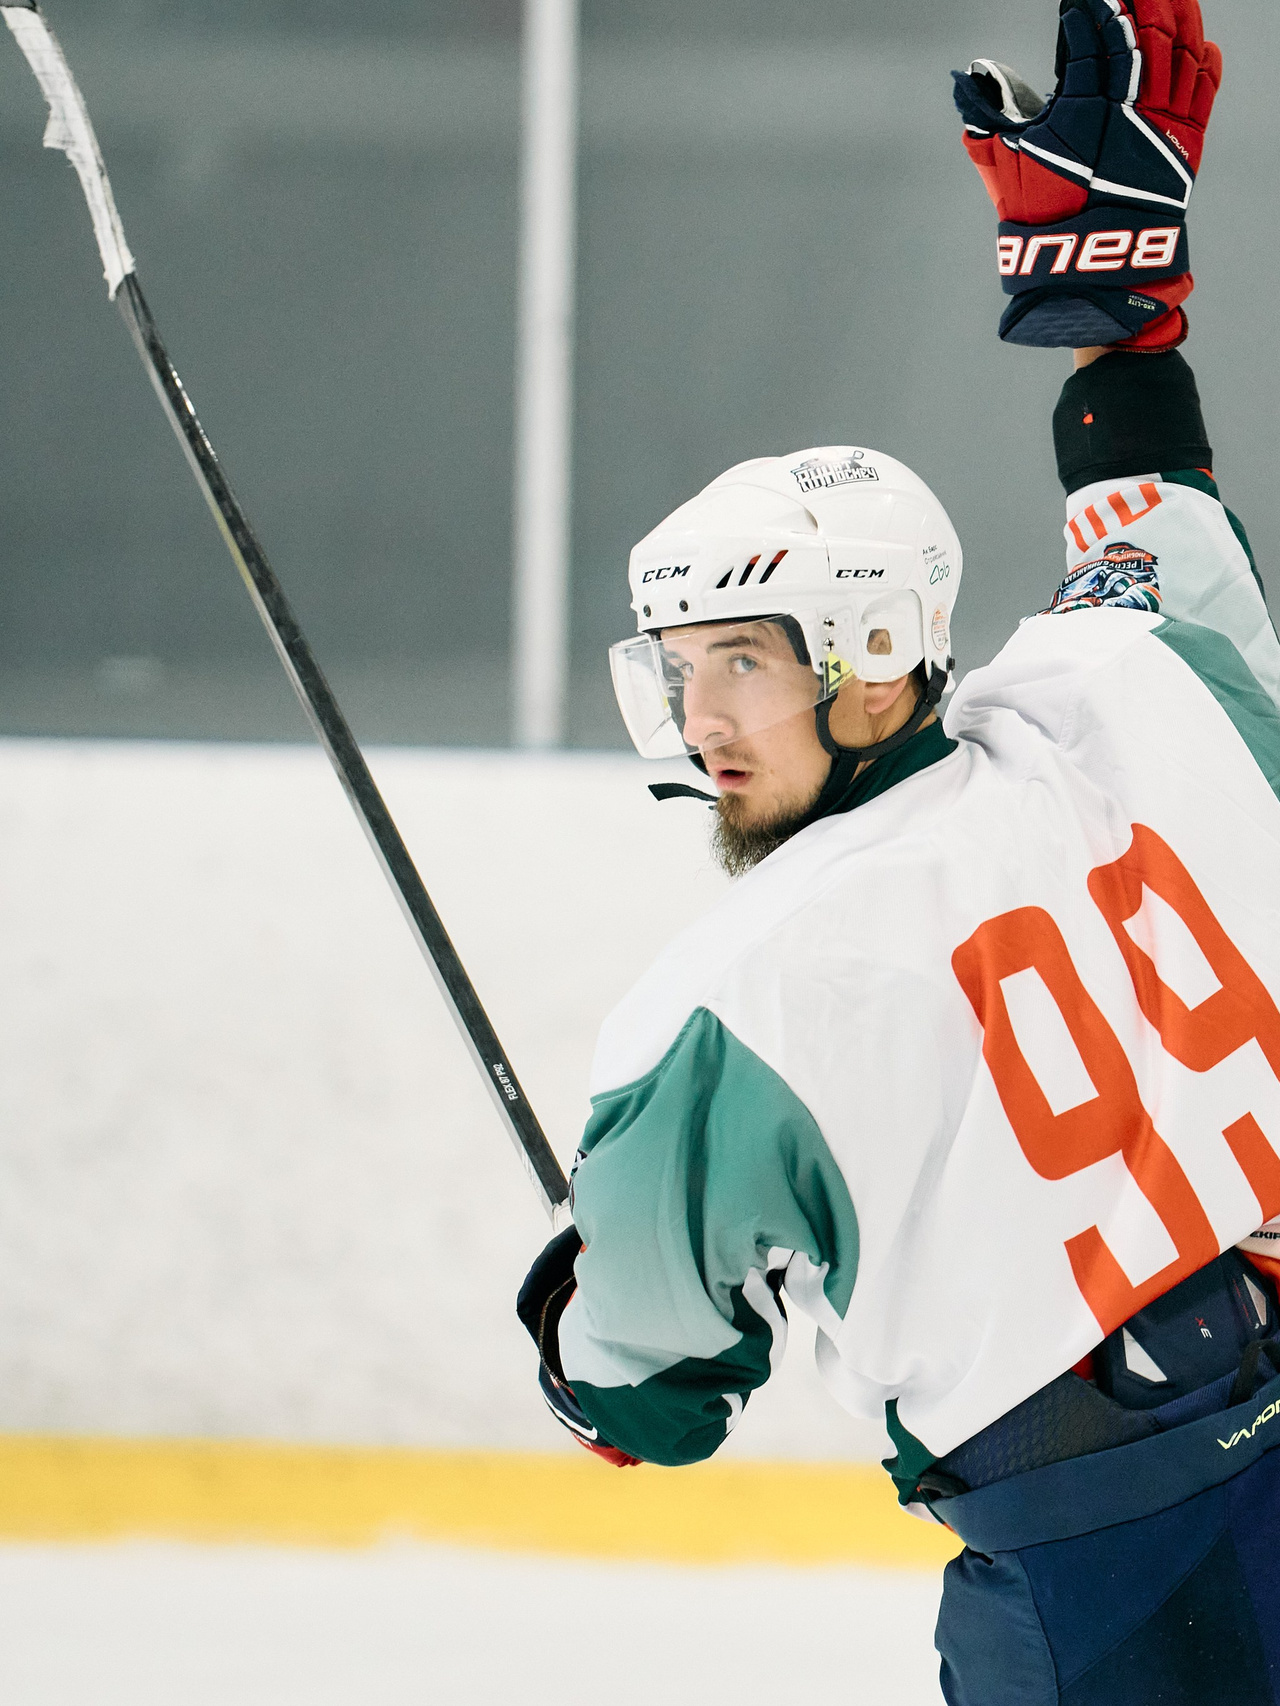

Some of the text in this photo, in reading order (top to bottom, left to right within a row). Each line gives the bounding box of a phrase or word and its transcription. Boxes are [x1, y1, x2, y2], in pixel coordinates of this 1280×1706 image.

[1165, 129, 1189, 160] VAPOR
[642, 565, 691, 584] CCM
[835, 569, 885, 578] CCM
[499, 1076, 510, 1084] 87
[502, 1082, 519, 1101] FLEX
